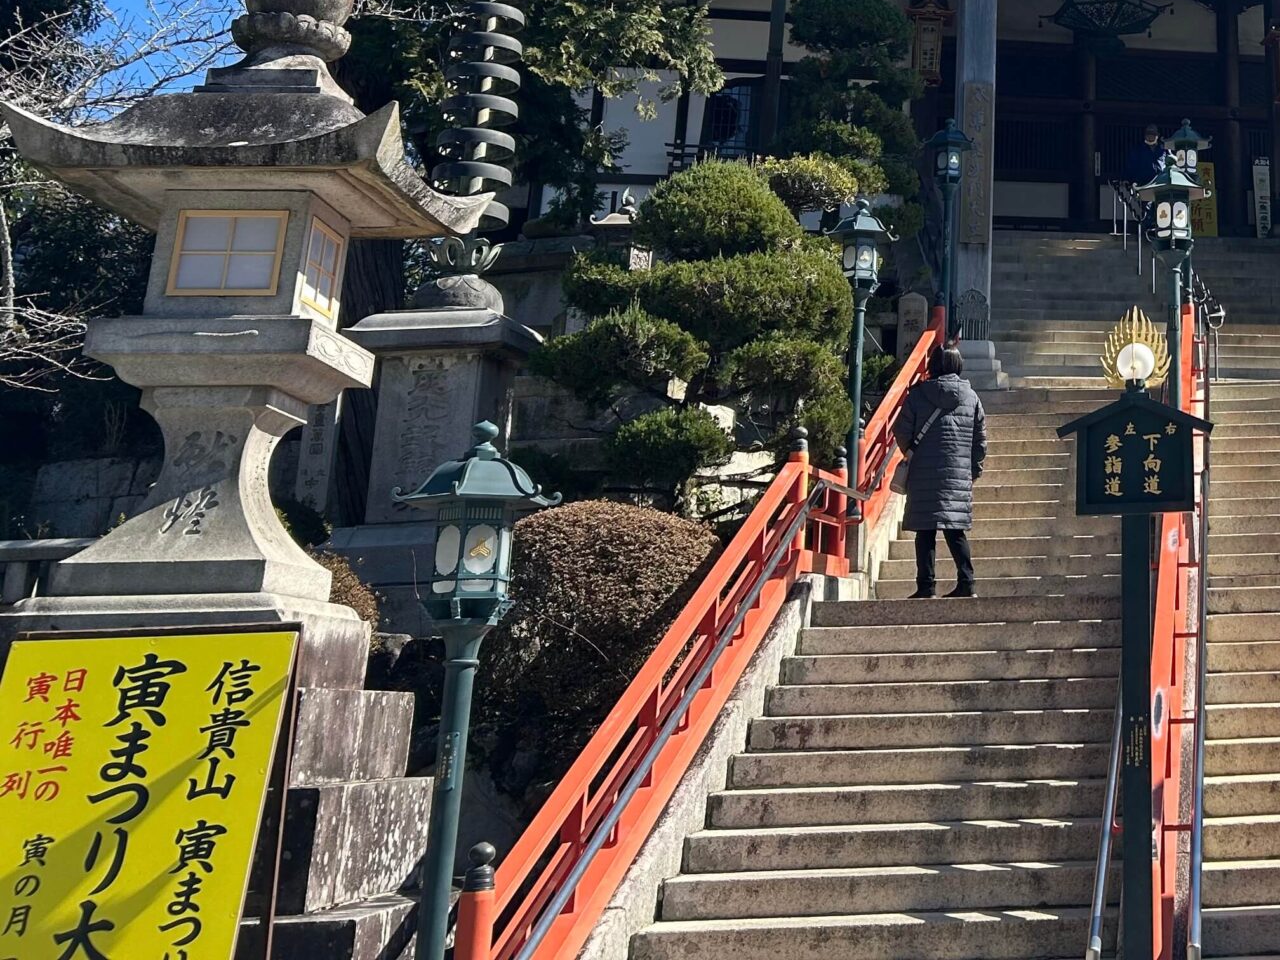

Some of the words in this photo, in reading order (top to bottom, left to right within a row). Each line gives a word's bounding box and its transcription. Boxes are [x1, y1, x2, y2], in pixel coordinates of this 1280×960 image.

[1124, 422, 1136, 435] 左
[1143, 433, 1162, 495] 下向道
[1165, 422, 1177, 435] 右
[34, 668, 88, 801] 日本唯一の
[186, 659, 261, 801] 信貴山
[53, 653, 188, 960] 寅まつり大
[1, 834, 55, 937] 寅の月
[157, 820, 227, 960] 寅まつ
